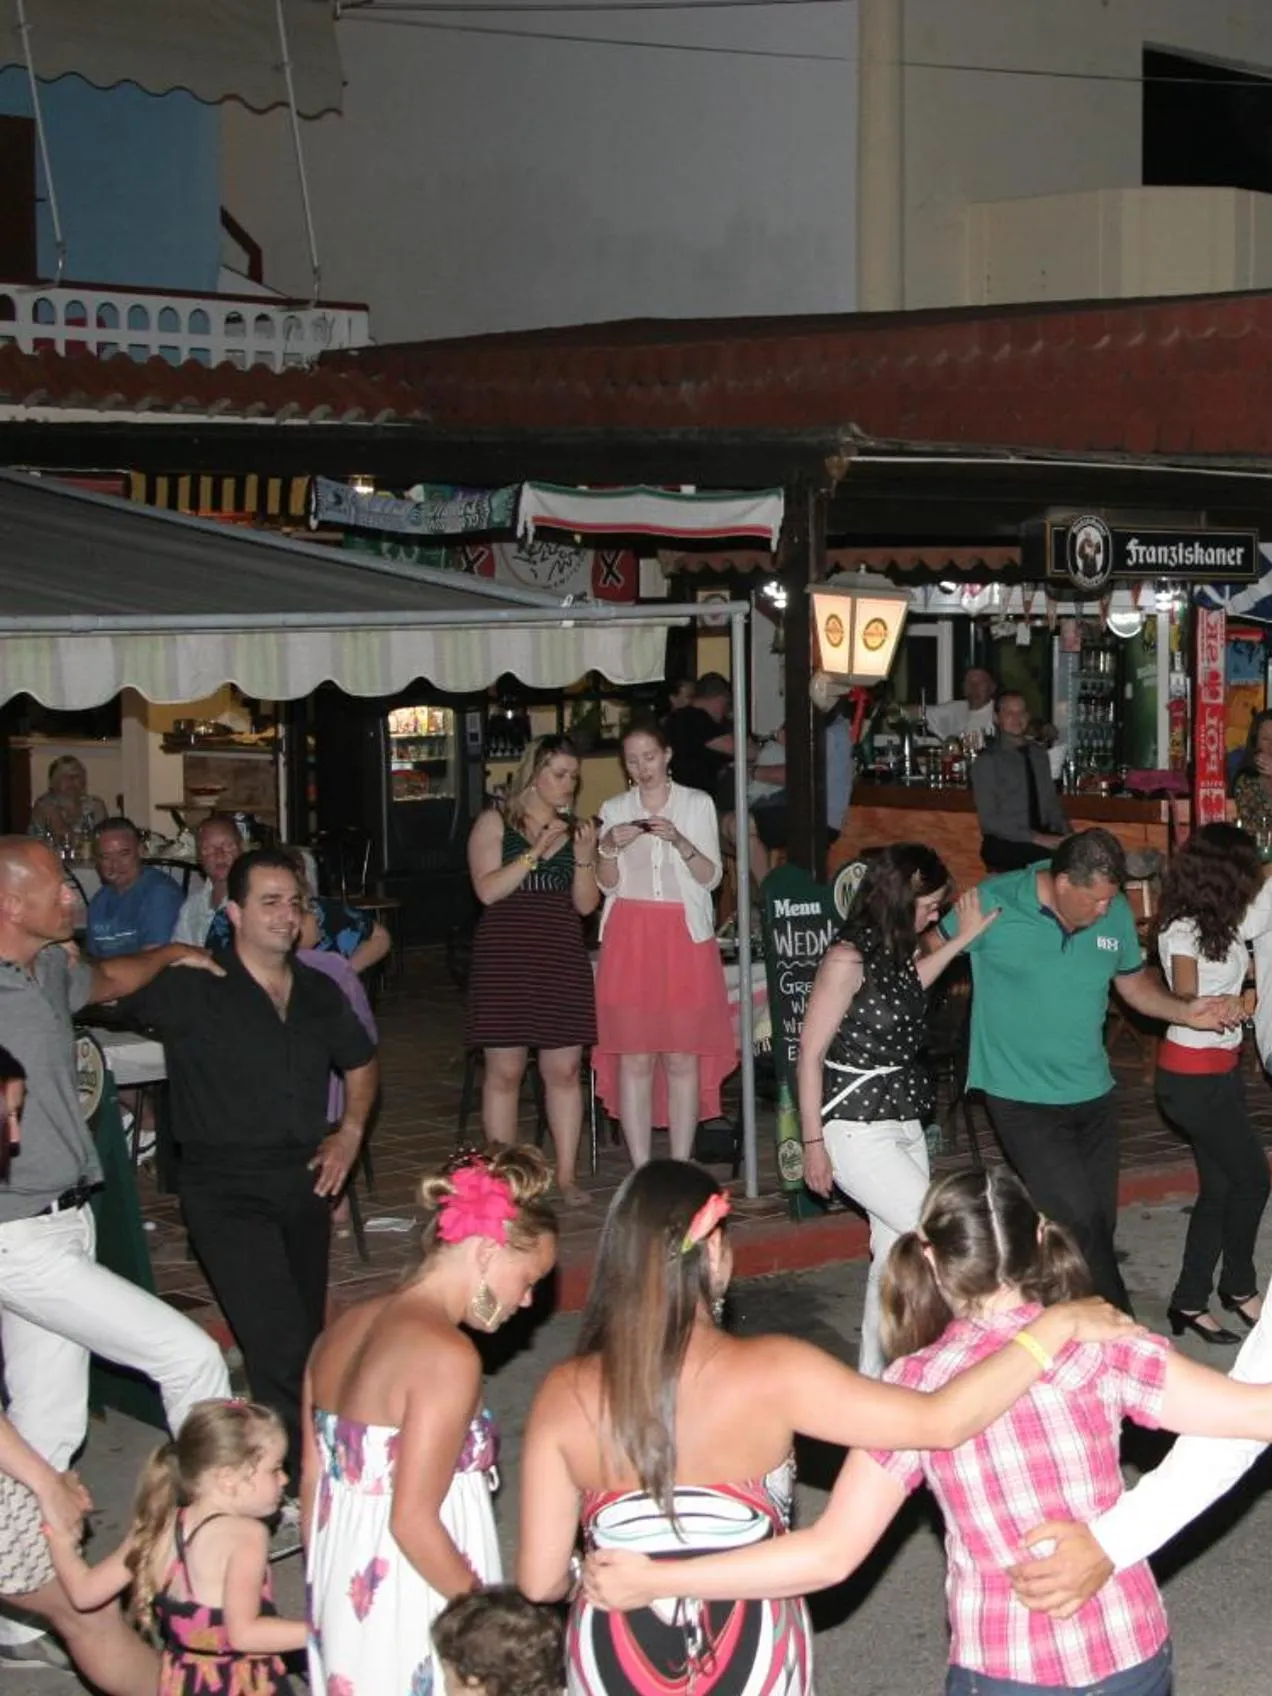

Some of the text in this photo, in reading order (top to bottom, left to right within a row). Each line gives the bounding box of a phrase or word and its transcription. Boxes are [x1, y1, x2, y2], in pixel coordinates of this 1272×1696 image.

[1126, 537, 1245, 567] Franziskaner
[774, 899, 822, 918] Menu
[773, 919, 838, 957] WEDN
[780, 971, 813, 996] GRE
